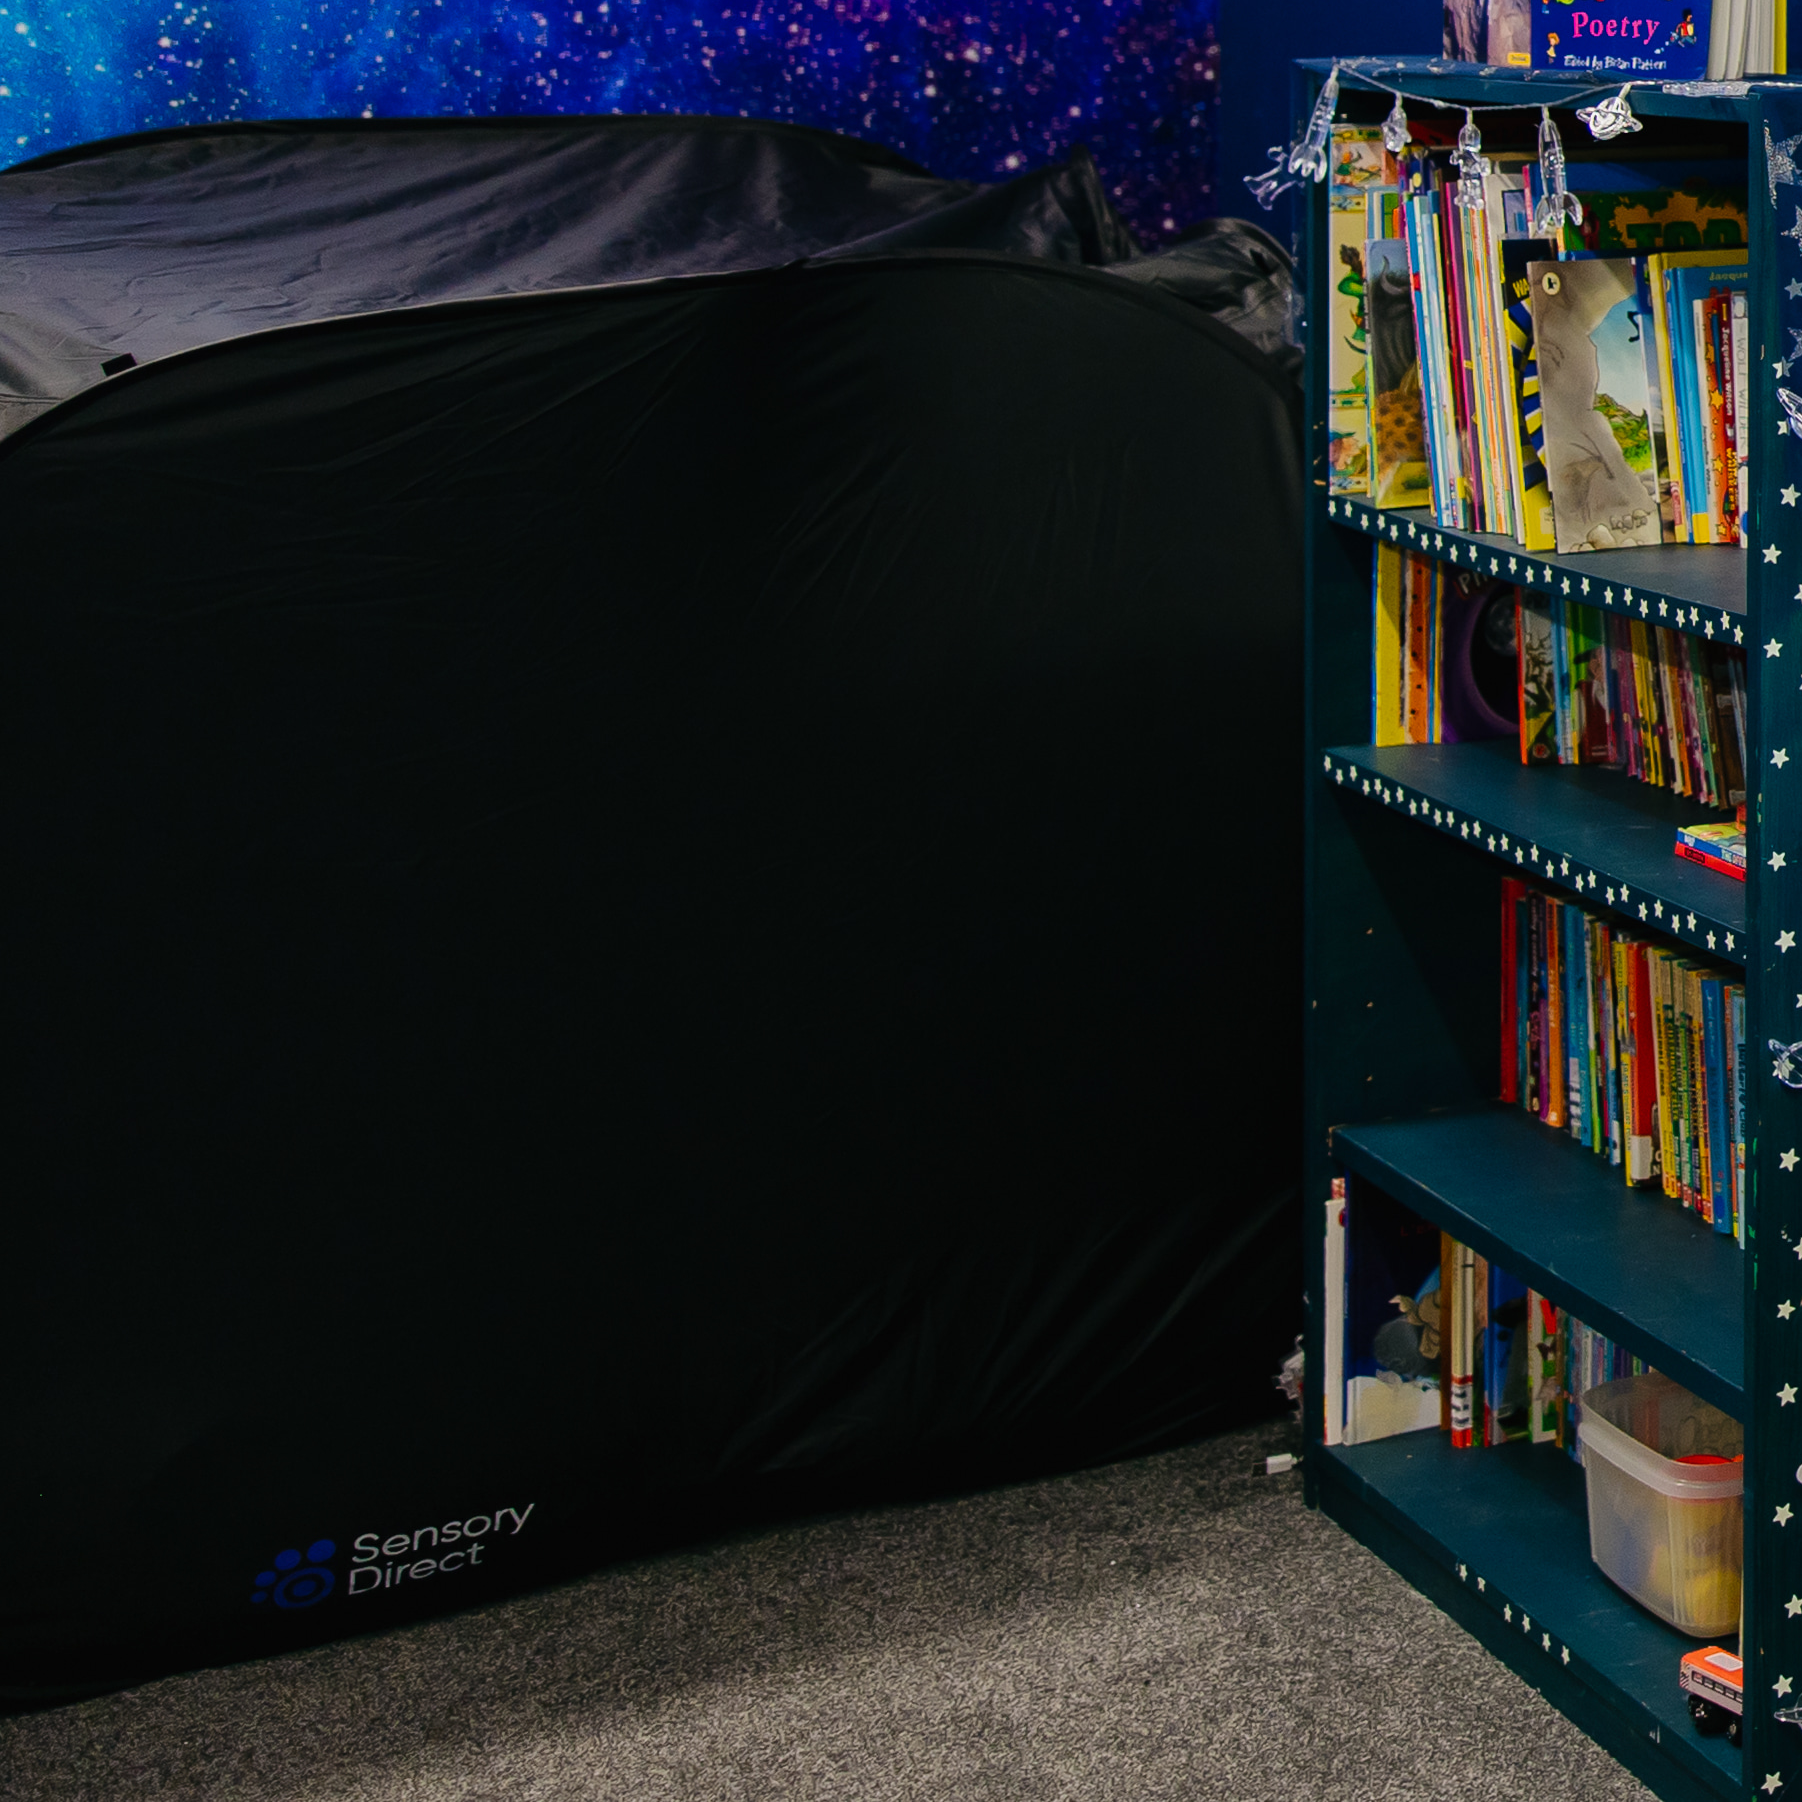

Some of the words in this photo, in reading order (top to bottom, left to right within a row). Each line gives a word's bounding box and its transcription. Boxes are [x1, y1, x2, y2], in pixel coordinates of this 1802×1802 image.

[1572, 11, 1660, 45] Poetry
[1563, 55, 1590, 67] Edited
[1592, 56, 1602, 70] by
[1604, 55, 1630, 69] Brian
[1632, 57, 1667, 70] Patten
[1721, 327, 1731, 380] Jacqueline
[1725, 382, 1733, 416] Wilson
[351, 1502, 535, 1565] Sensory
[348, 1542, 485, 1595] Direct
